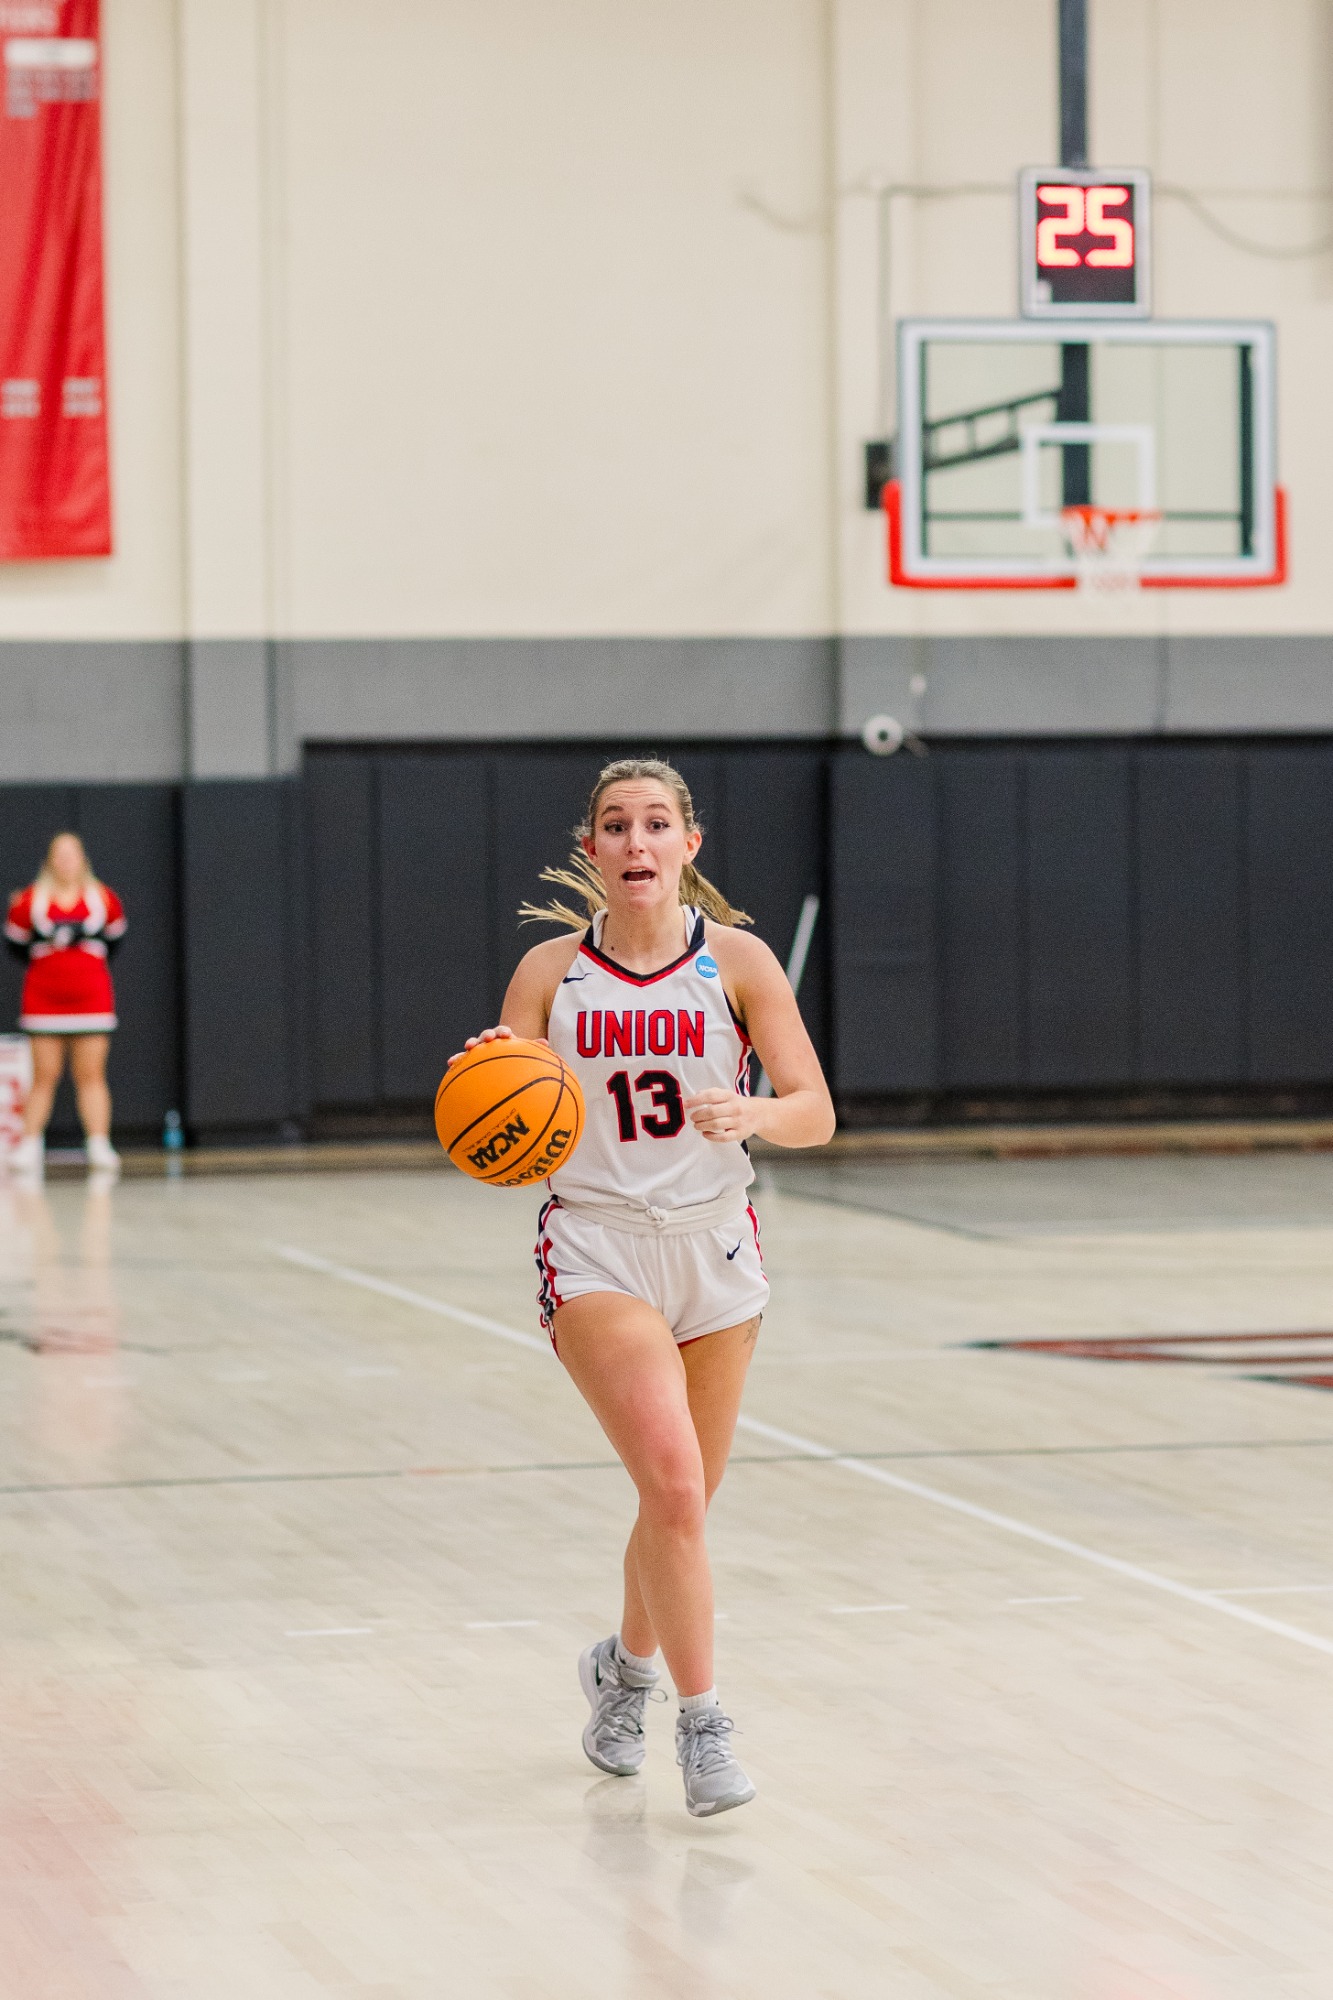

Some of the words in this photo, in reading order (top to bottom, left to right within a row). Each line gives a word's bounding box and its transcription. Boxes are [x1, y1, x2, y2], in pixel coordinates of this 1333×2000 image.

[1036, 186, 1134, 268] 25
[698, 964, 719, 974] NCAA
[576, 1009, 705, 1058] UNION
[606, 1069, 686, 1142] 13
[467, 1113, 530, 1170] NCAA
